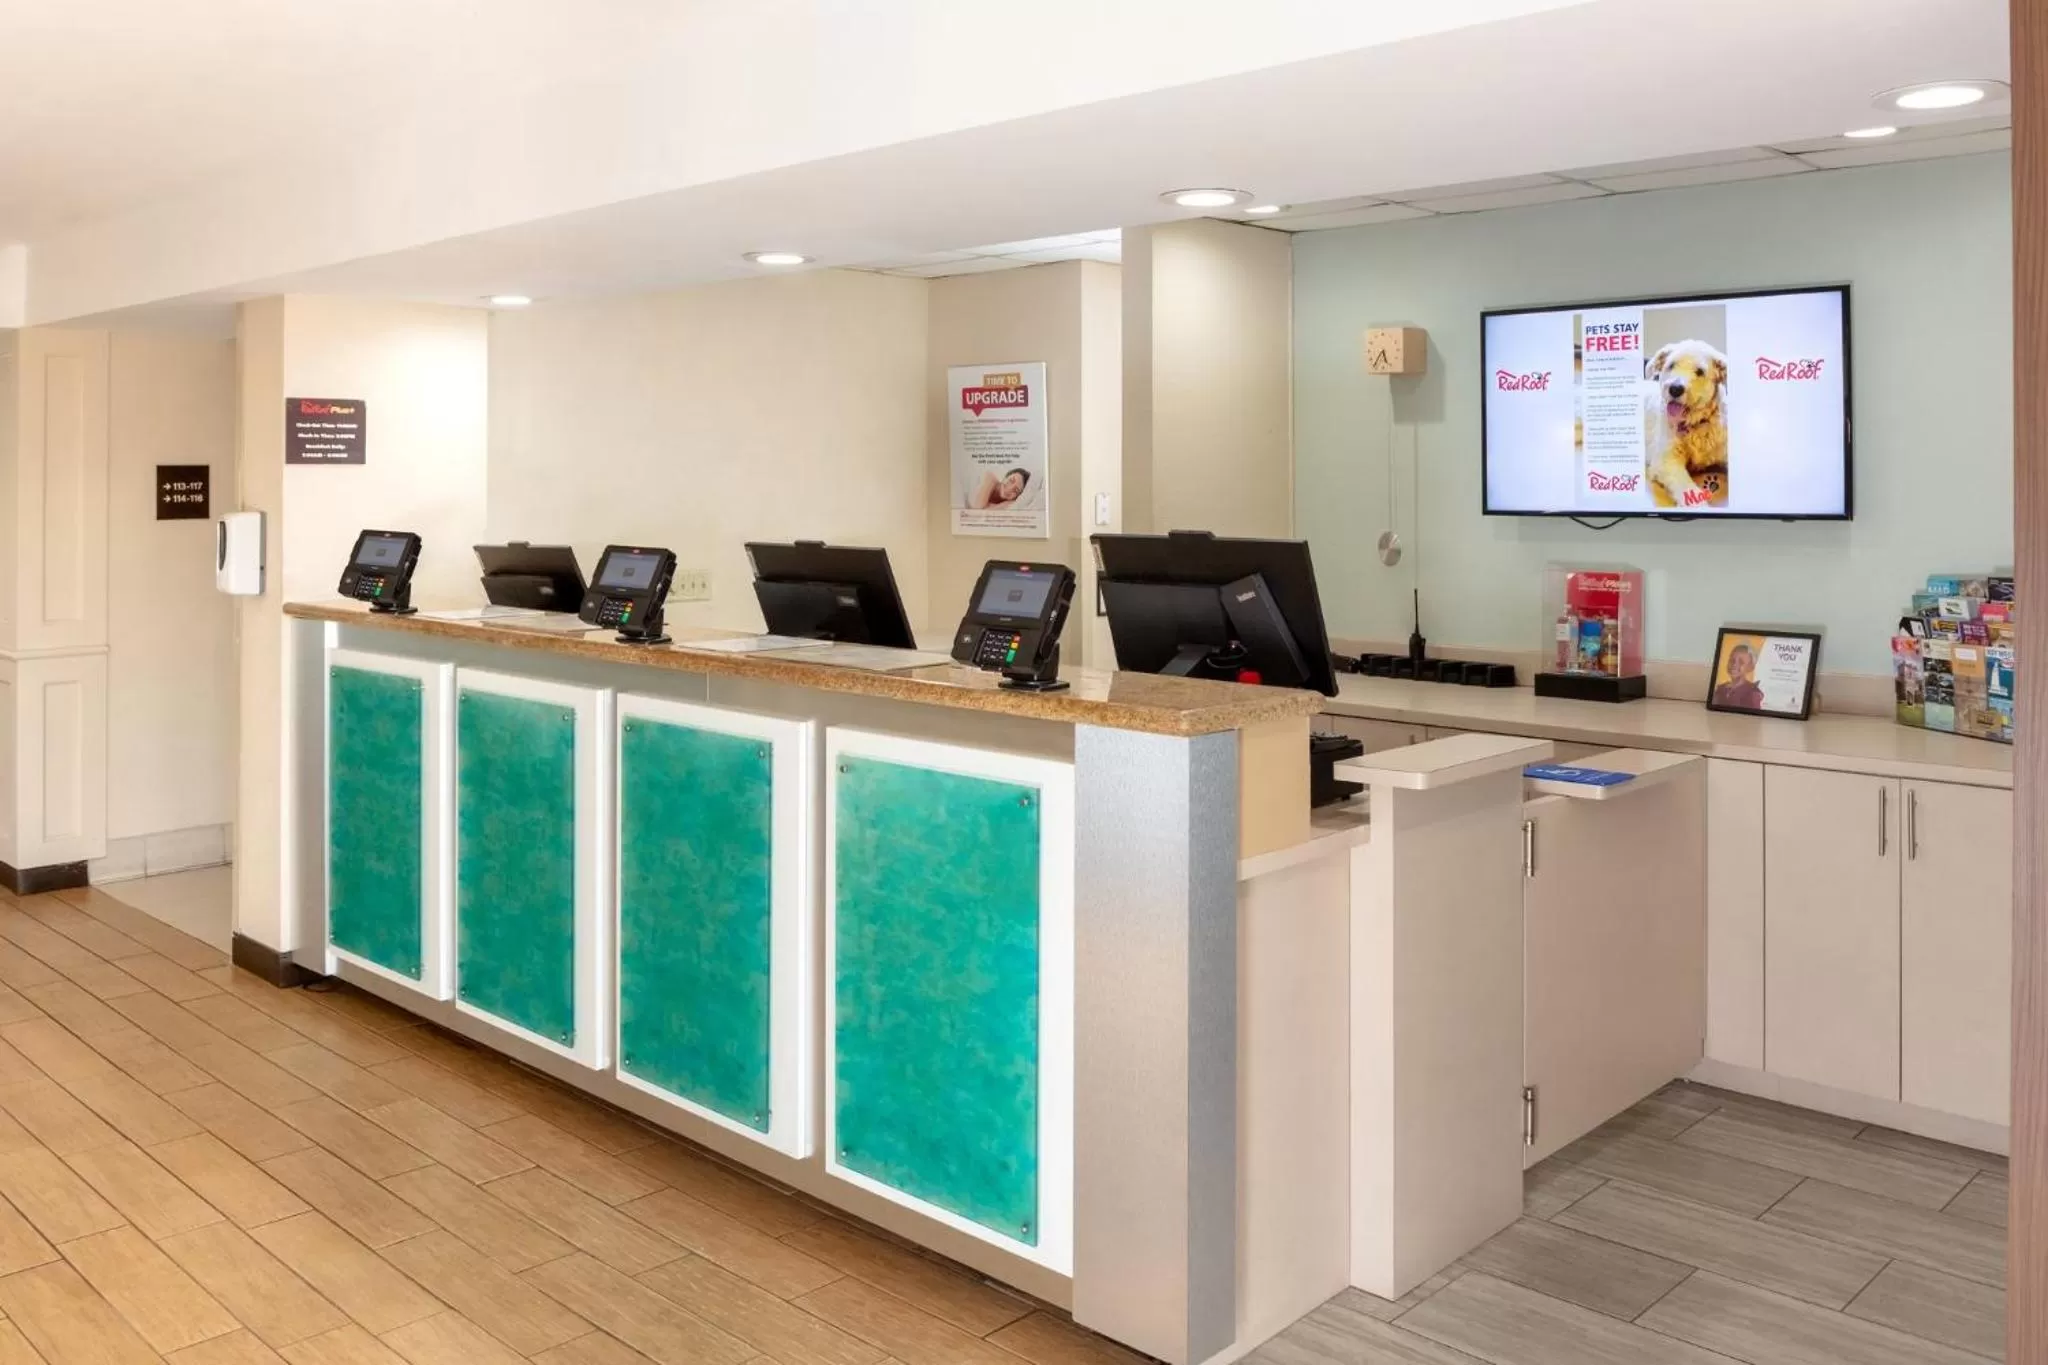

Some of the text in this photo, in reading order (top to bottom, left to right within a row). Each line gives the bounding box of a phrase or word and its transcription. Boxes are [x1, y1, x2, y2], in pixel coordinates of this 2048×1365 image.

[1586, 323, 1639, 335] PETS STAY
[1586, 335, 1639, 352] FREE!
[1007, 375, 1018, 385] TO
[965, 390, 1025, 405] UPGRADE
[1774, 644, 1803, 653] THANK
[1779, 653, 1797, 661] YOU
